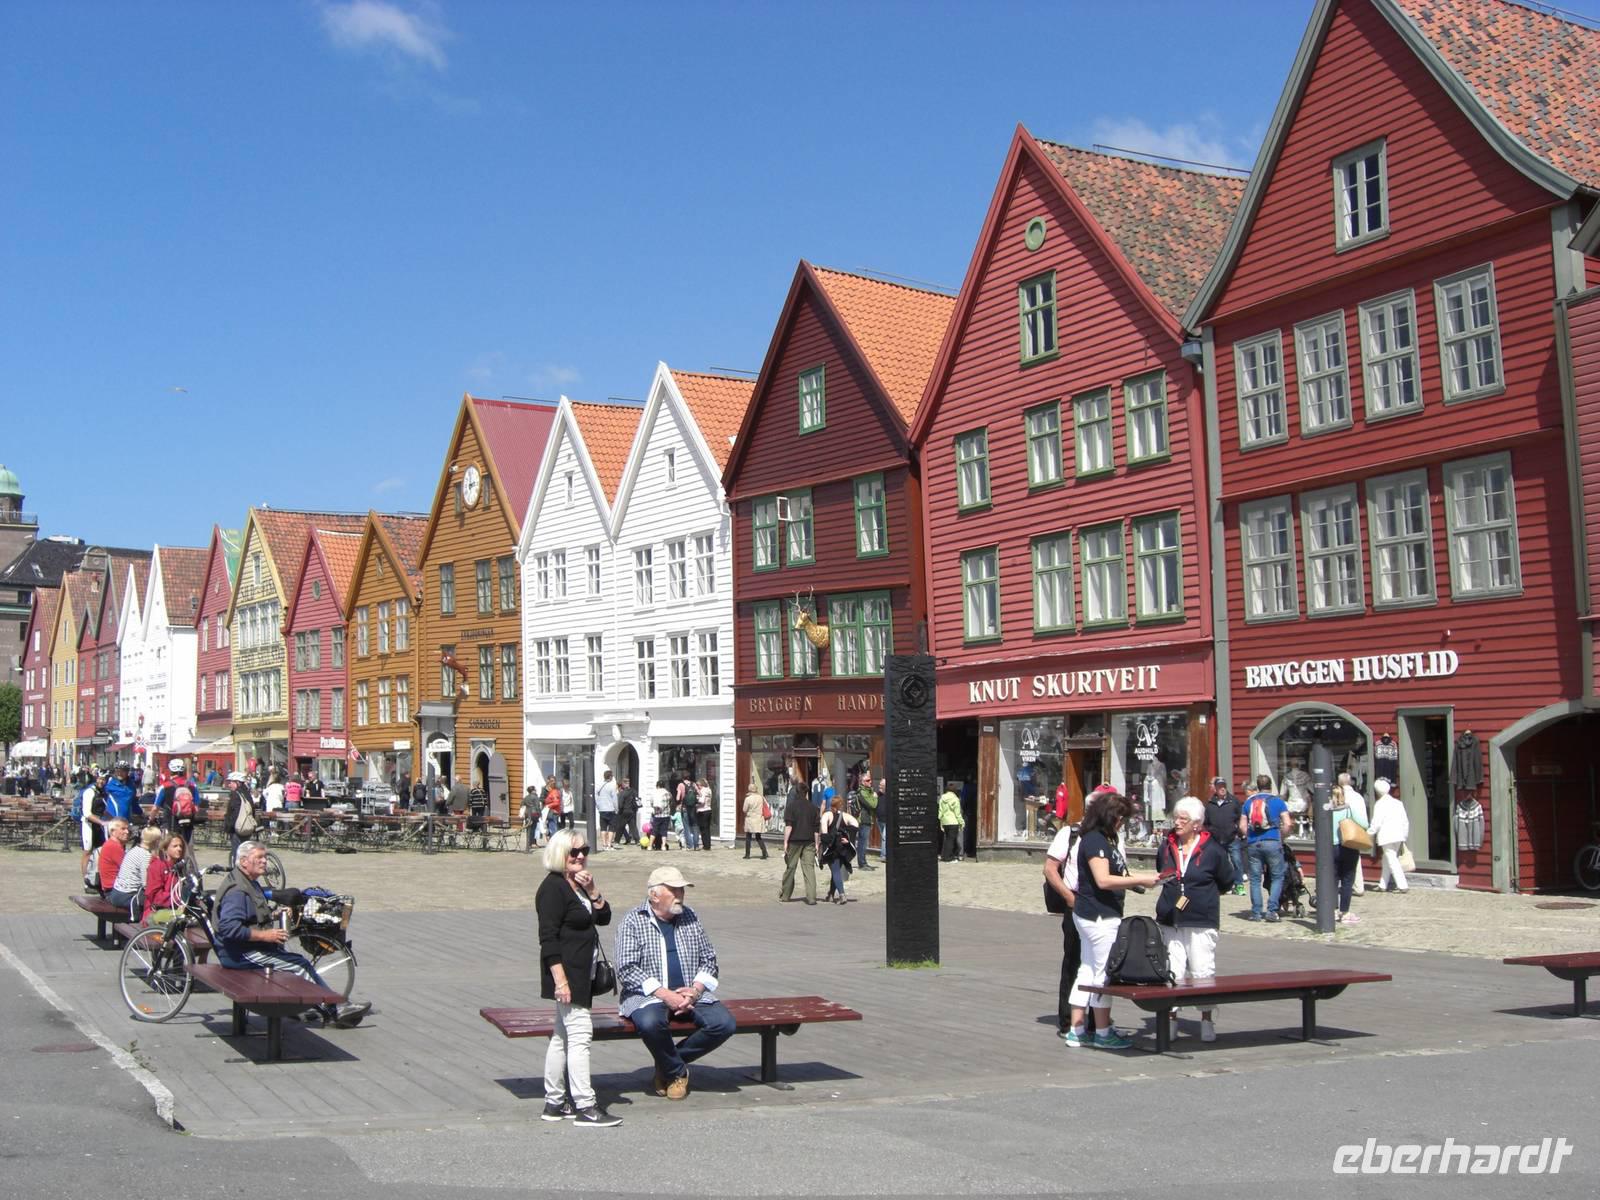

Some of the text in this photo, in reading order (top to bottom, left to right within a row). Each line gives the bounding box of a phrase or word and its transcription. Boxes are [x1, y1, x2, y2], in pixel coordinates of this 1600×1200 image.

[969, 665, 1161, 704] KNUT SKURTVEIT
[1245, 650, 1459, 689] BRYGGEN HUSFLID
[749, 695, 814, 713] BRYGGEN
